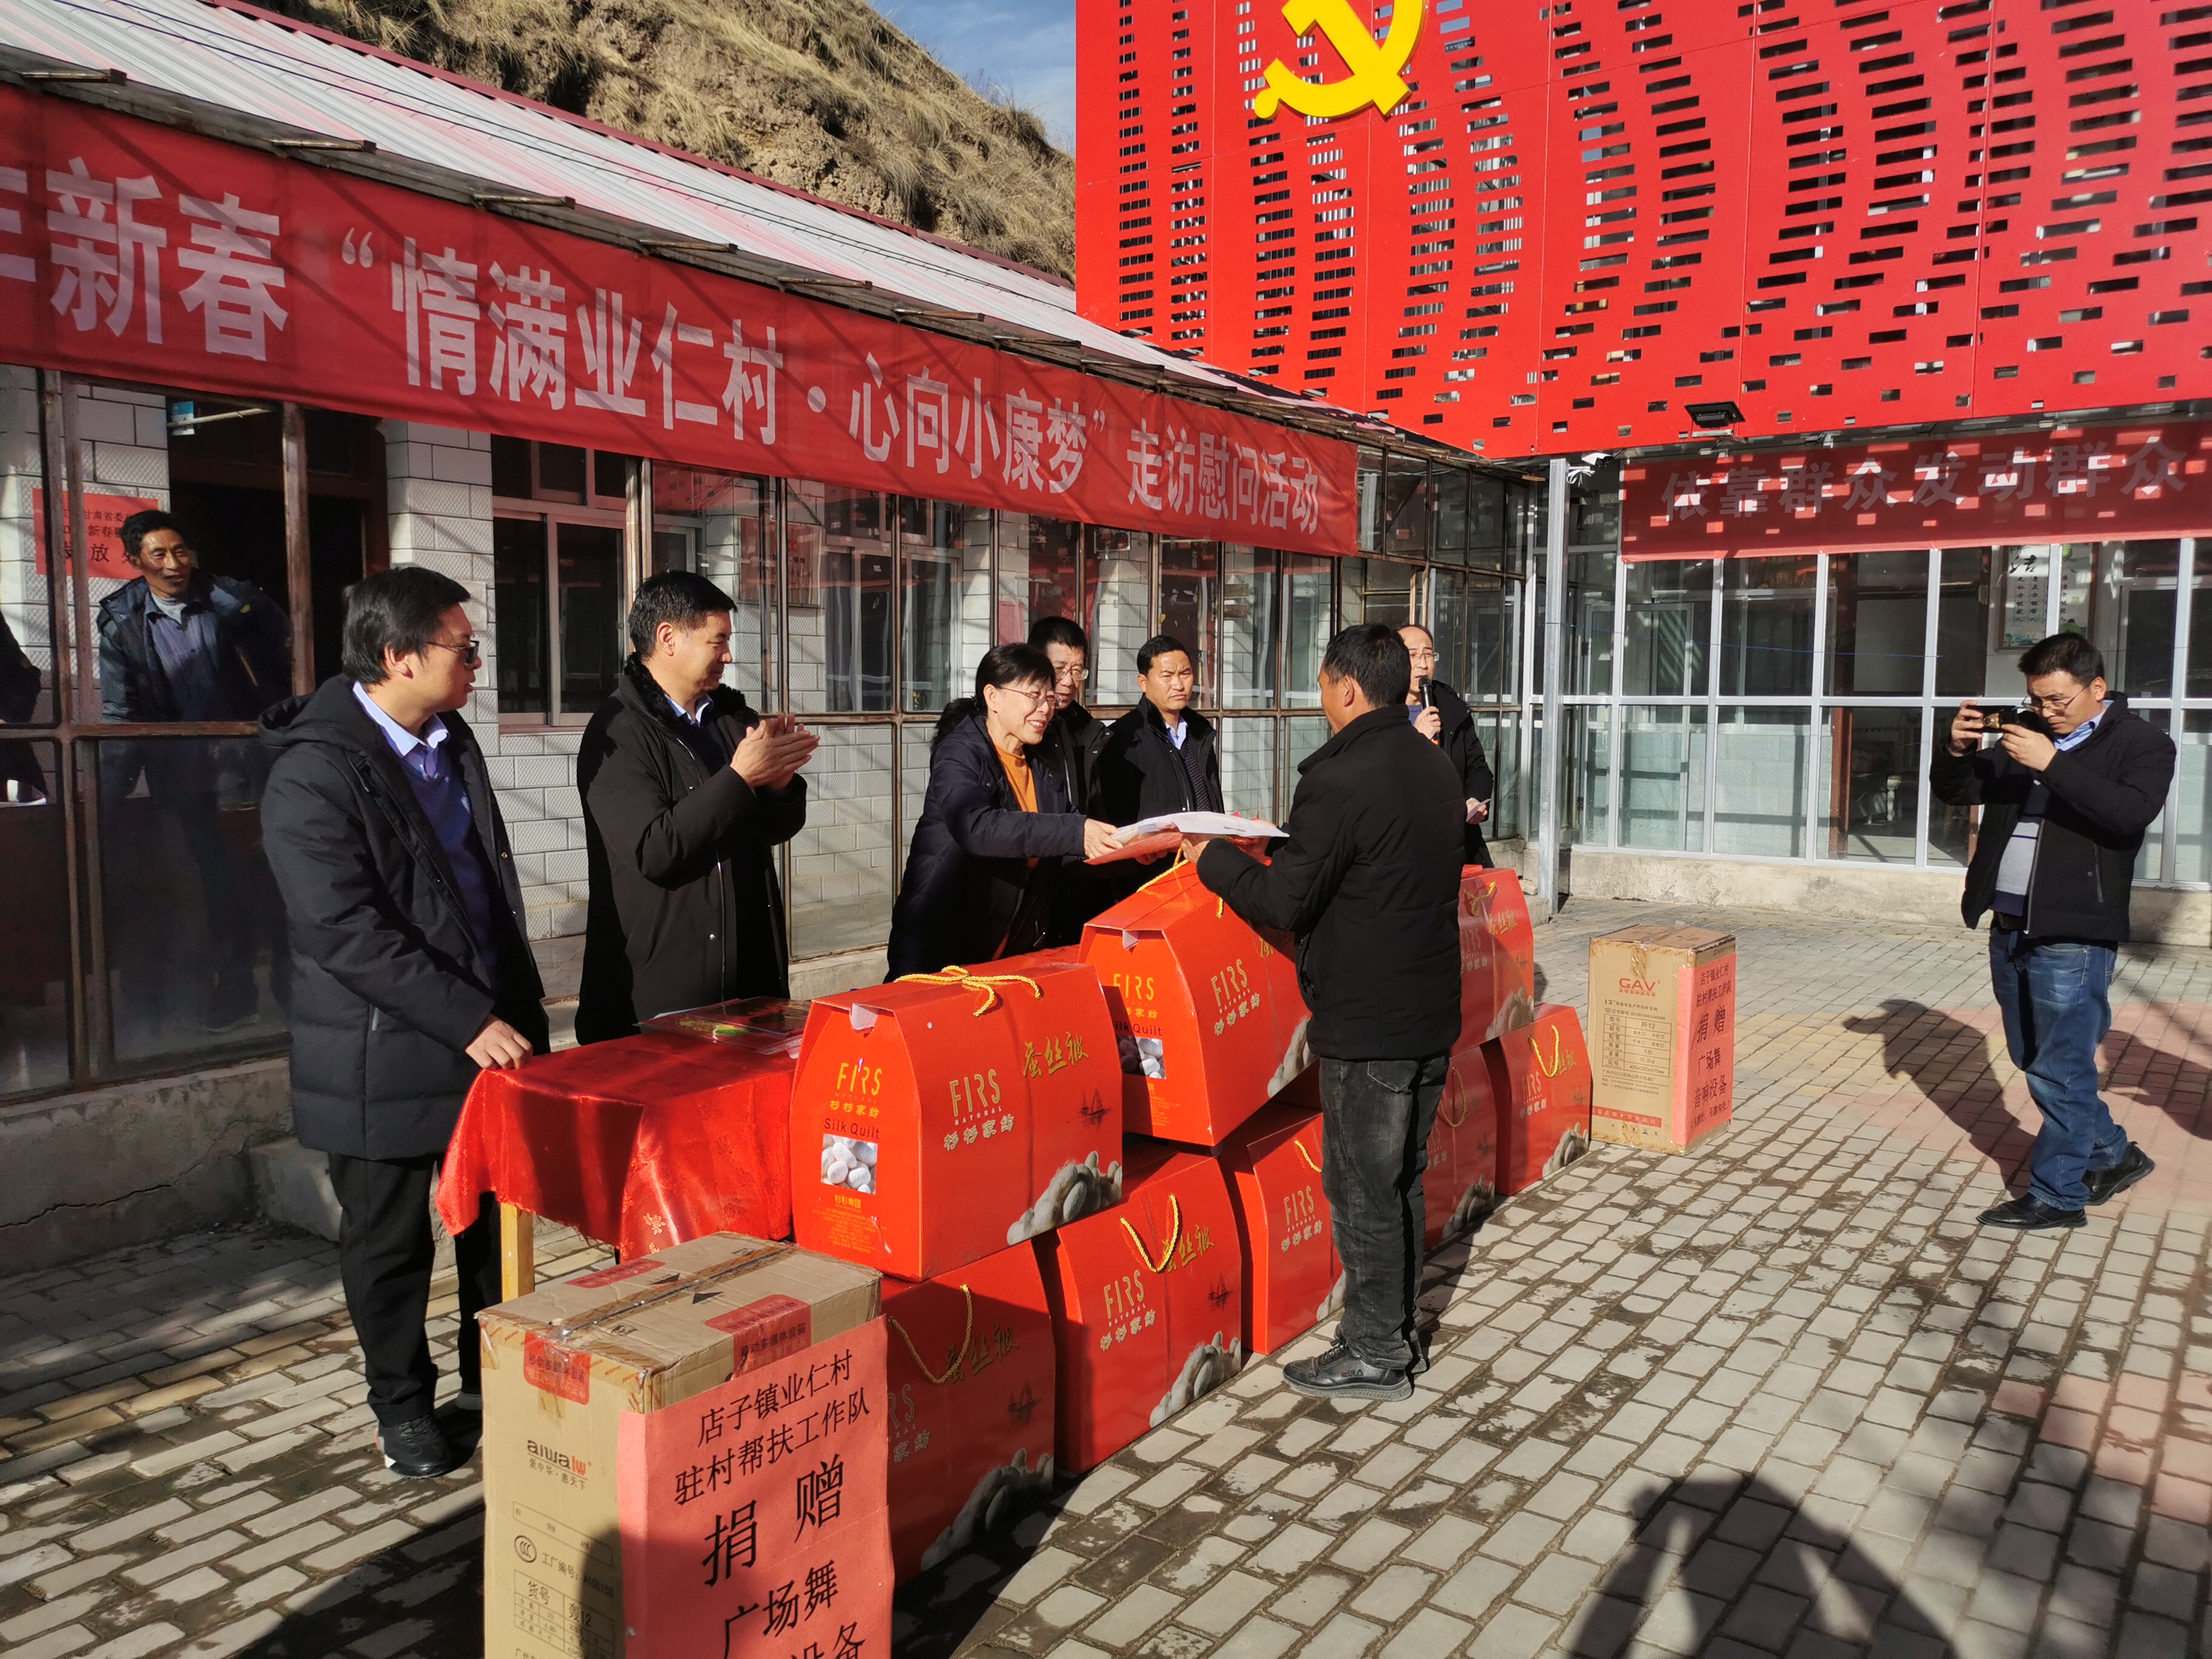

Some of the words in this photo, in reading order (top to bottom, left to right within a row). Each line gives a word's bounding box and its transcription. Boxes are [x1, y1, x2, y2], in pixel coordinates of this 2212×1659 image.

[1127, 418, 1319, 535] 走访慰问活动
[1211, 959, 1248, 1008] FIRS
[1618, 977, 1656, 991] GAV
[1133, 1023, 1162, 1036] Quilt
[836, 1062, 883, 1096] FIRS
[1698, 1047, 1721, 1076] 广场舞
[950, 1068, 1002, 1118] FIRS
[1521, 1071, 1541, 1100] FIRS
[829, 1100, 880, 1119] 杉杉家纺
[954, 1104, 1003, 1125] NATURAL
[823, 1117, 847, 1133] Silk
[850, 1122, 880, 1140] Quilt
[943, 1114, 1015, 1151] 杉杉家纺
[1284, 1185, 1314, 1225] FIRS
[1104, 1270, 1144, 1319] FIRS
[697, 1350, 853, 1448] 店子镇业仁村
[888, 1384, 915, 1429] RS
[674, 1387, 871, 1506] 驻村帮扶工作队
[893, 1430, 931, 1463] 家纺
[702, 1454, 845, 1587] 捐赠
